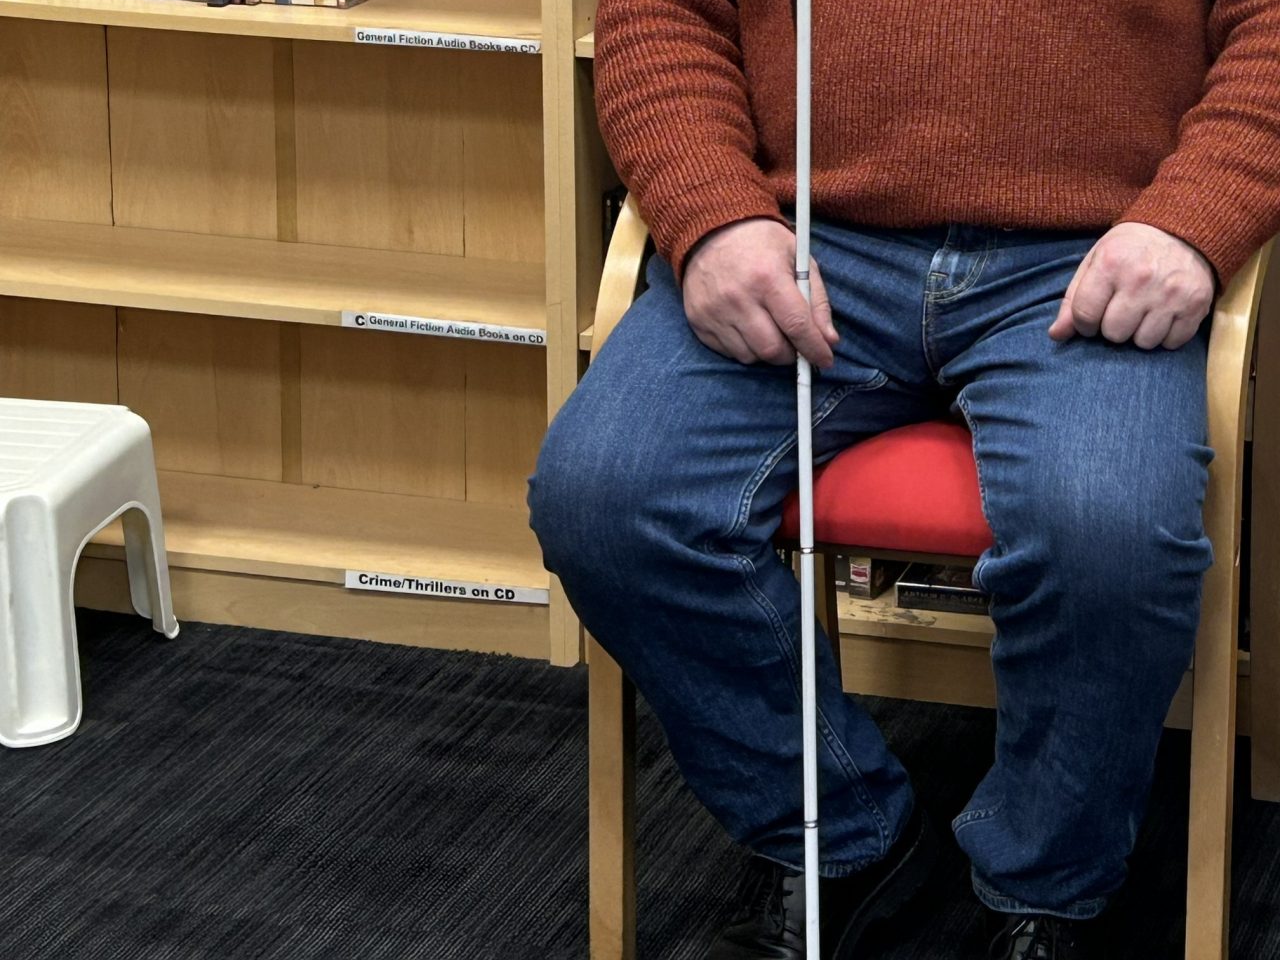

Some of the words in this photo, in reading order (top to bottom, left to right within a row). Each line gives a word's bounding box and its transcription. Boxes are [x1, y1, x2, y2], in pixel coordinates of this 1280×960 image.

[357, 31, 396, 43] General
[399, 34, 434, 46] Fiction
[436, 37, 466, 49] Audio
[469, 40, 501, 51] Books
[354, 315, 366, 326] C
[369, 316, 408, 329] General
[410, 320, 444, 333] Fiction
[446, 324, 476, 337] Audio
[478, 328, 510, 340] Books
[512, 333, 526, 343] on
[528, 334, 544, 344] CD
[358, 573, 467, 596] Crime/Thrillers
[471, 587, 489, 598] on
[494, 588, 516, 600] CD
